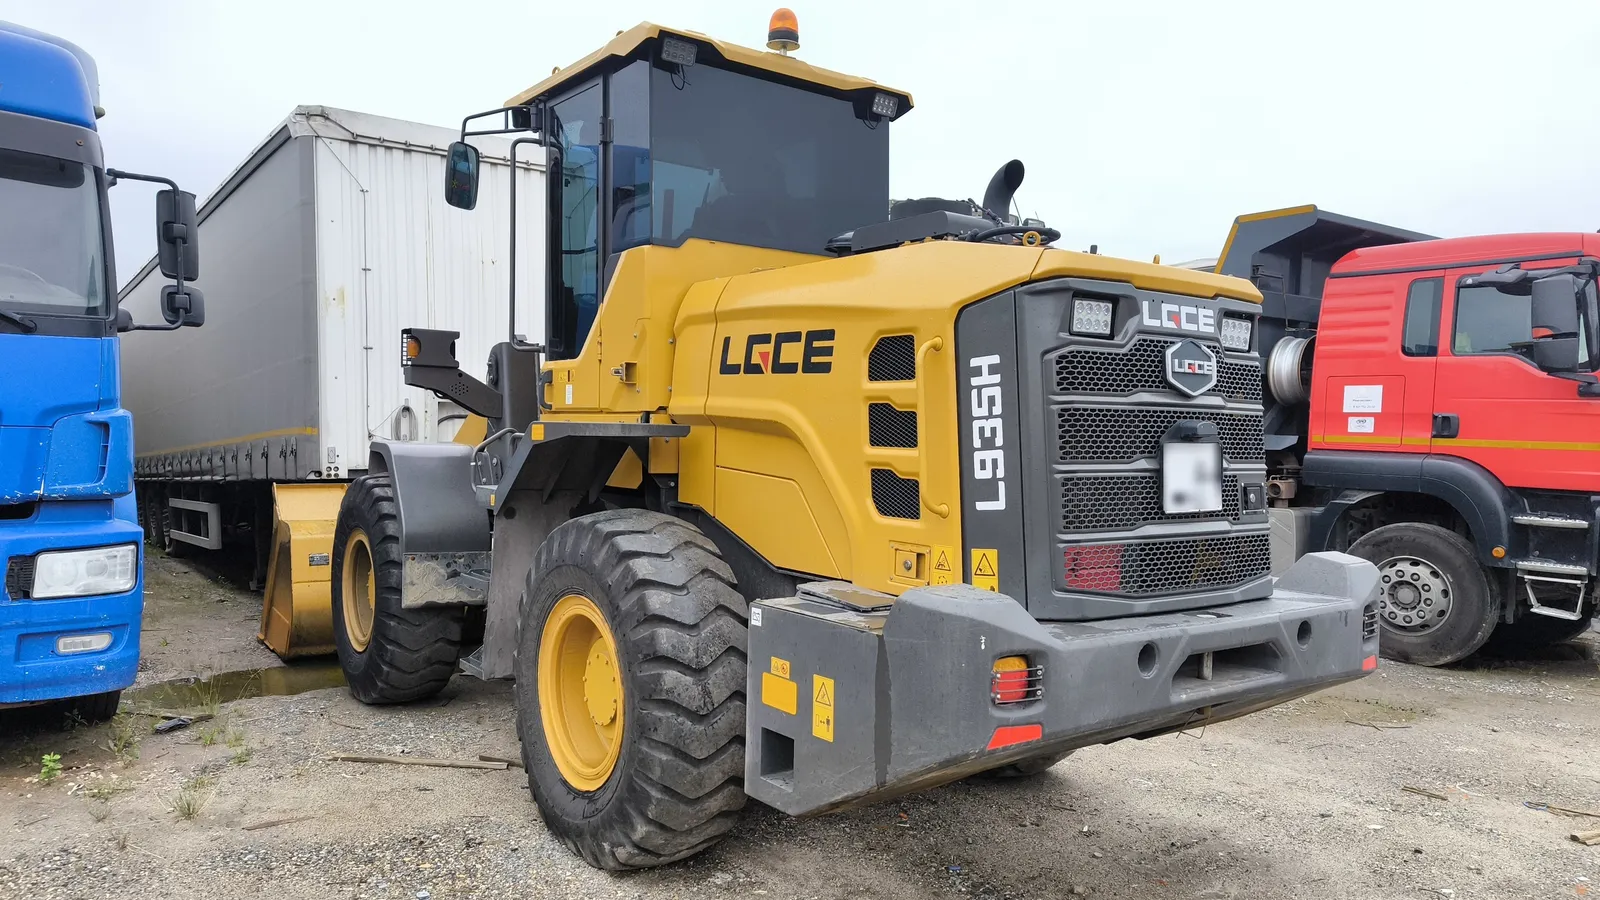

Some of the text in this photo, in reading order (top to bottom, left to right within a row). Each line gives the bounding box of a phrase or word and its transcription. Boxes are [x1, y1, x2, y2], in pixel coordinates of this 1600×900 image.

[1142, 300, 1215, 333] LGCE
[719, 329, 836, 375] LGCE
[969, 354, 1006, 511] L935H
